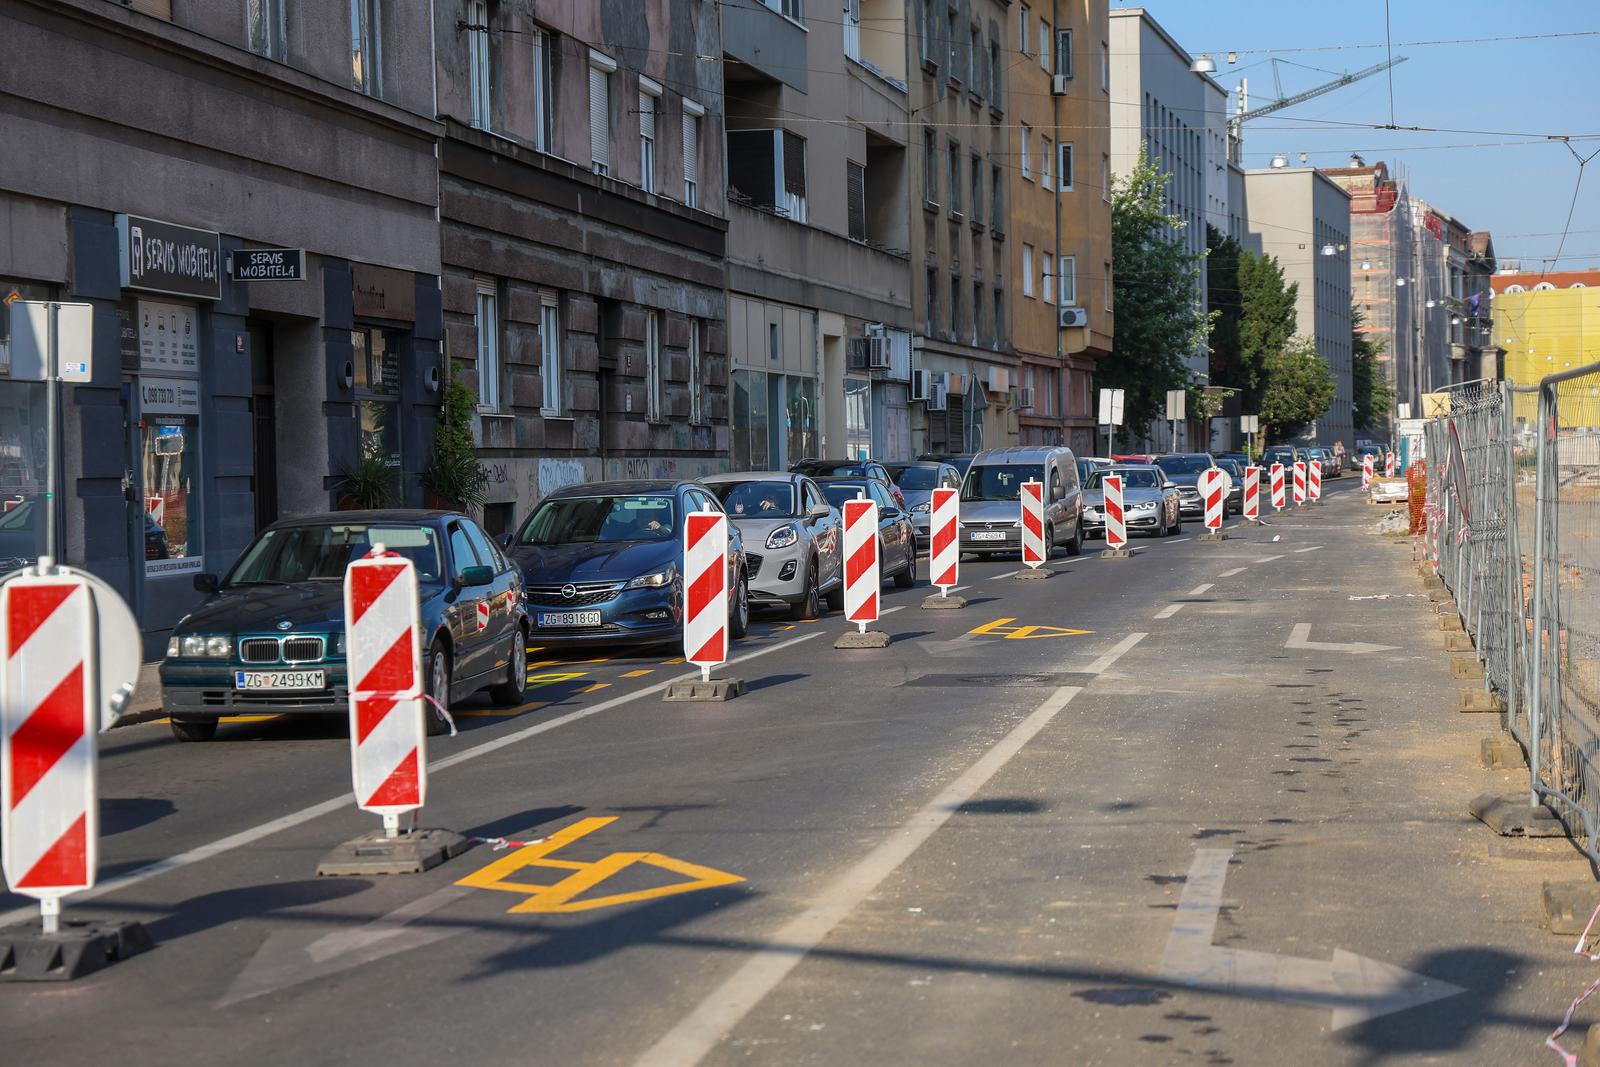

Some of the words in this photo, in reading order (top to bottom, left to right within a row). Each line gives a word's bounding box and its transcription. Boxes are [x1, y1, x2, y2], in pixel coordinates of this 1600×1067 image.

[146, 238, 175, 274] SERVIS
[177, 242, 218, 284] MOBITELA
[250, 252, 284, 264] SERVIS
[240, 264, 295, 277] MOBITELA
[545, 614, 557, 624] ZG
[246, 673, 262, 687] ZG
